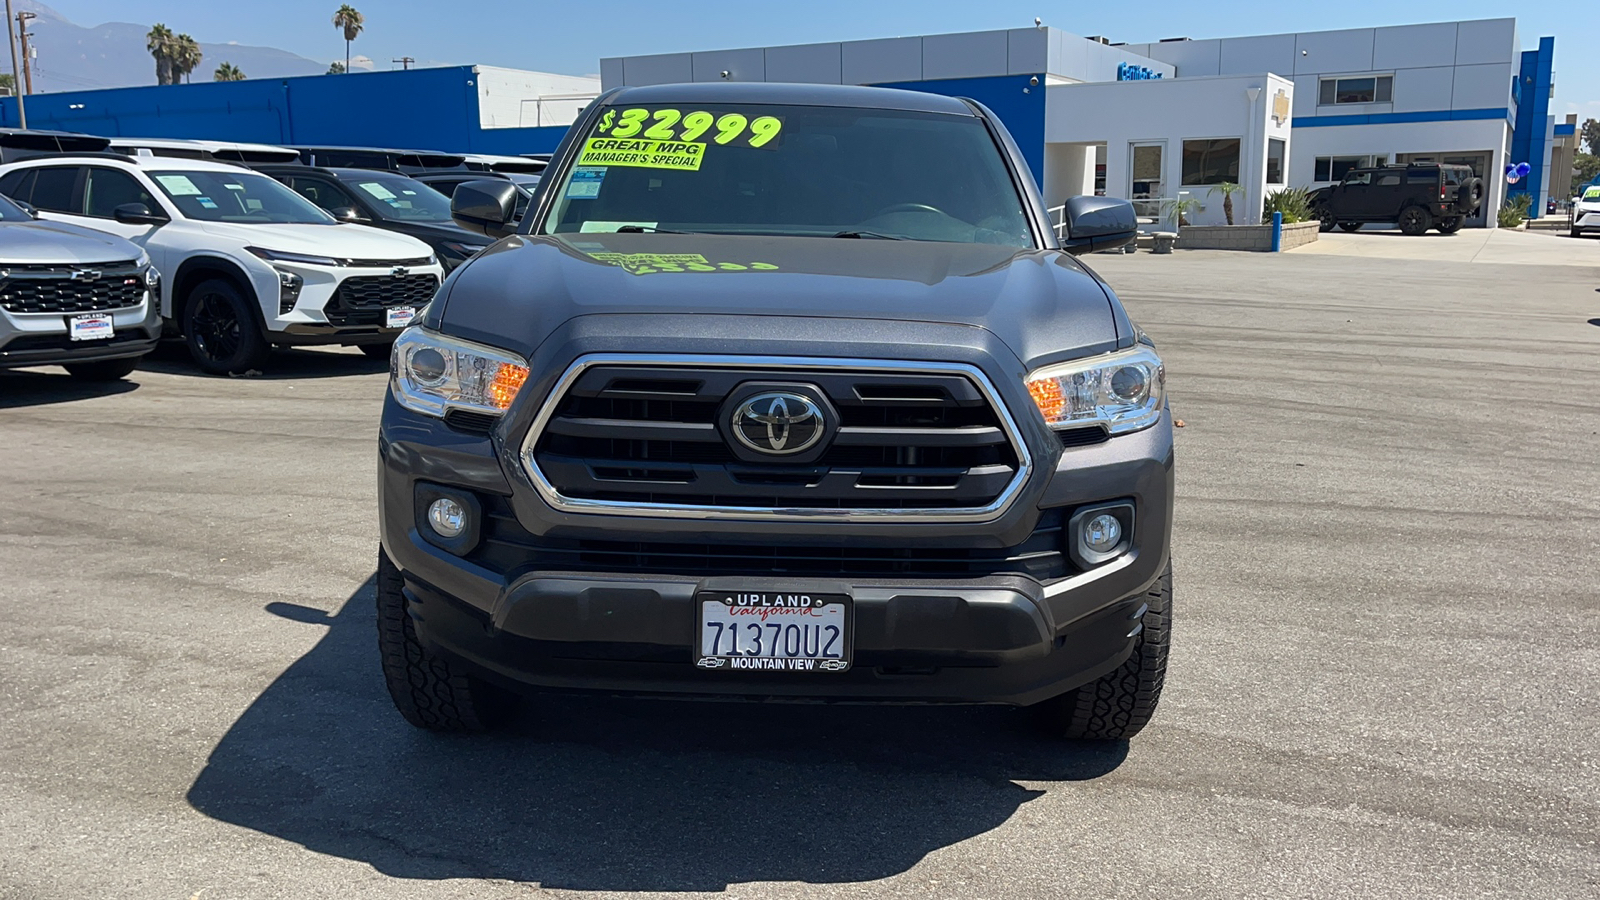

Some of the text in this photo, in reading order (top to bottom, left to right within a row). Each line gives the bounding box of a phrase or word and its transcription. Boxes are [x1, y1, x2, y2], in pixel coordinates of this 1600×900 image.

[599, 108, 782, 148] $32999
[591, 139, 700, 155] GREAT MPG
[582, 152, 697, 167] MANAGER'S SPECIAL
[737, 593, 811, 607] UPLAND
[729, 606, 823, 621] California
[707, 621, 840, 658] 71370U2
[731, 658, 814, 670] MOUNTAIN VIEW
